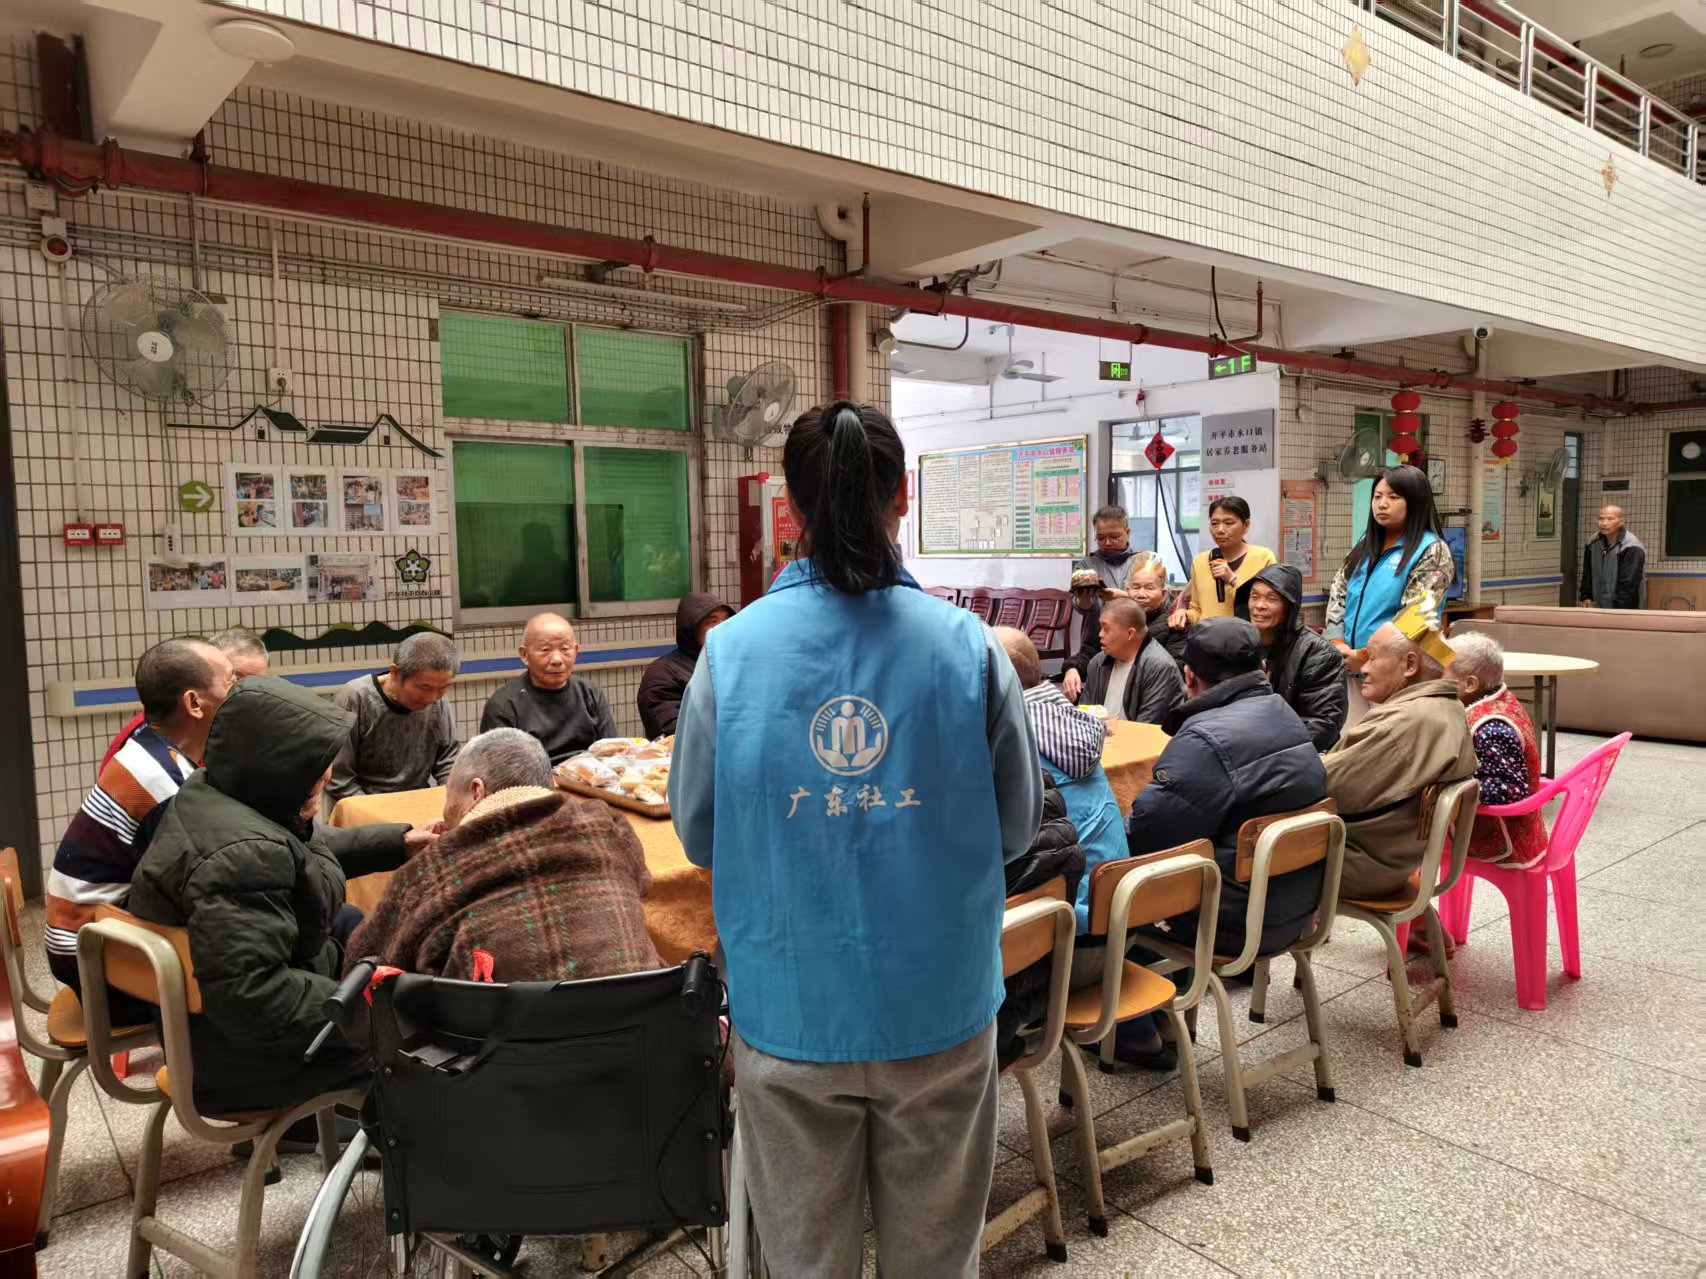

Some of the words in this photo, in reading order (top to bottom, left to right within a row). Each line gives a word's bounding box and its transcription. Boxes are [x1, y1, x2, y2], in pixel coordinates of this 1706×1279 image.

[1211, 426, 1263, 440] 开平市水口镇
[1206, 442, 1267, 457] 居家养老服务站
[787, 784, 921, 818] 广东社工
